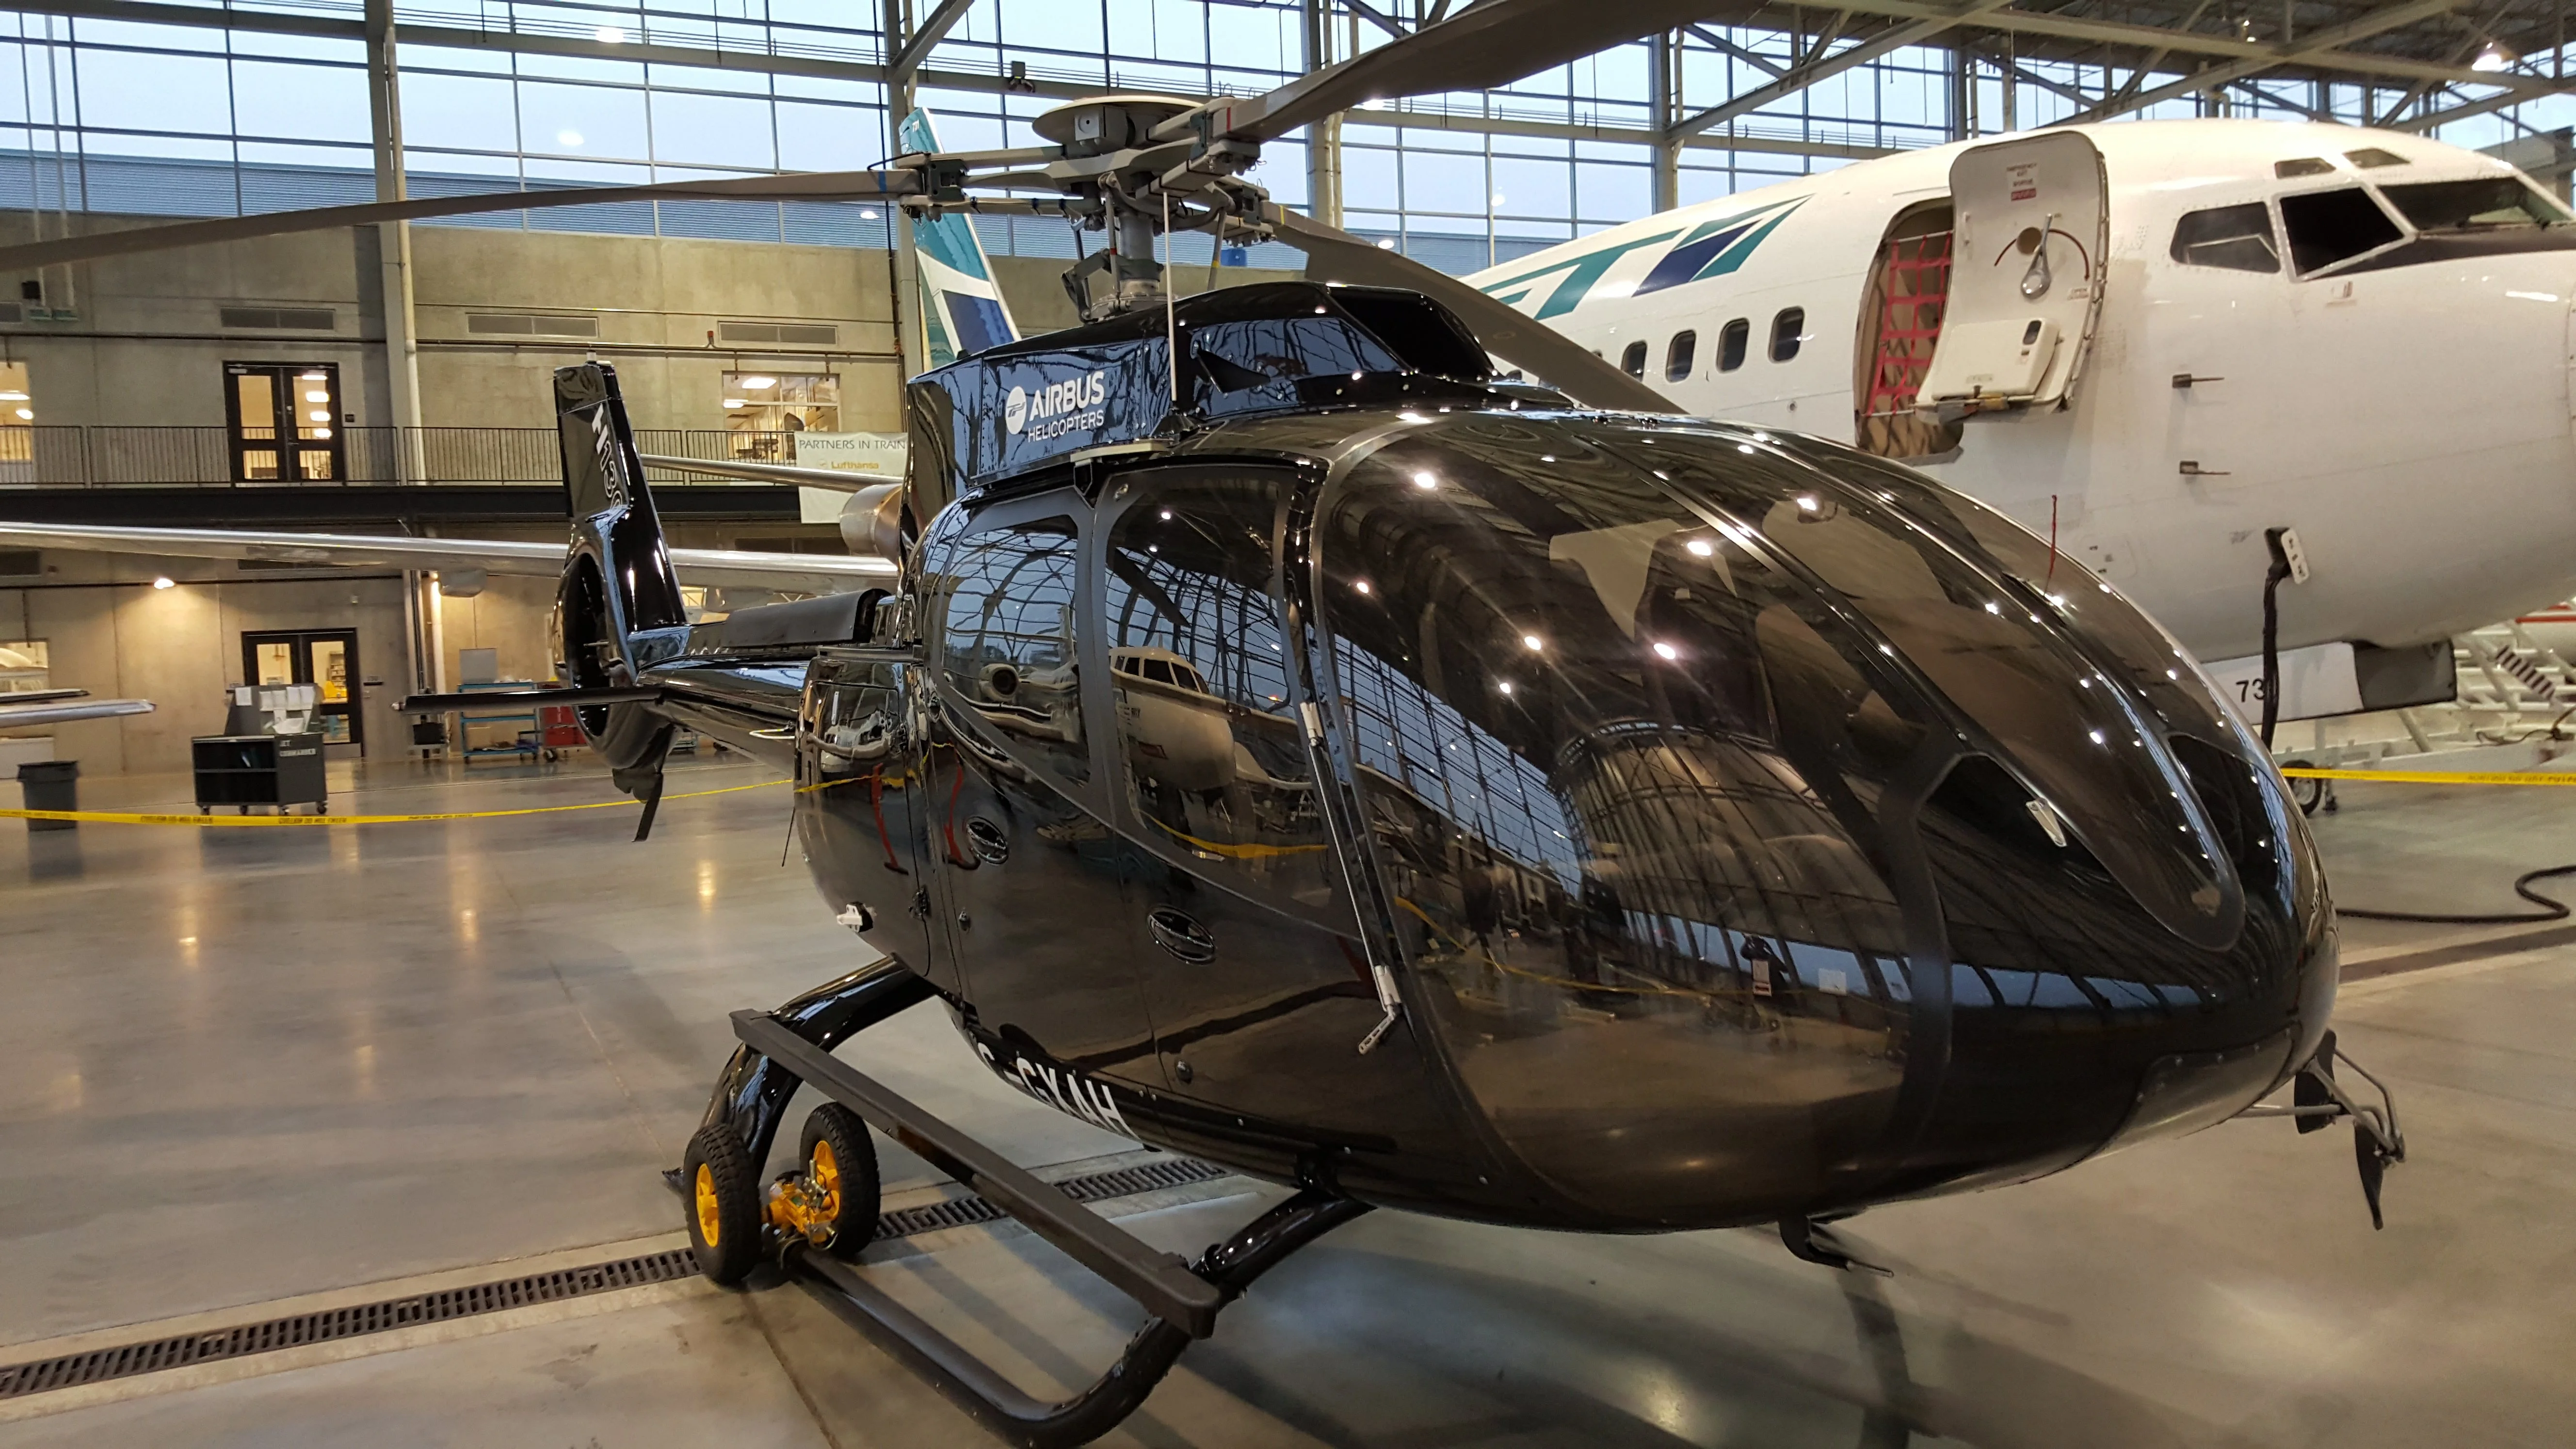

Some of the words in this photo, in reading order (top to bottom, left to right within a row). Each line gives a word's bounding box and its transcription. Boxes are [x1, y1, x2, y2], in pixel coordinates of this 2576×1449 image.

[1029, 371, 1104, 421] AIRBUS
[1028, 409, 1104, 443] HELICOPTERS
[799, 440, 854, 449] PARTNERS
[858, 440, 870, 449] IN
[874, 440, 906, 449] TRAIN
